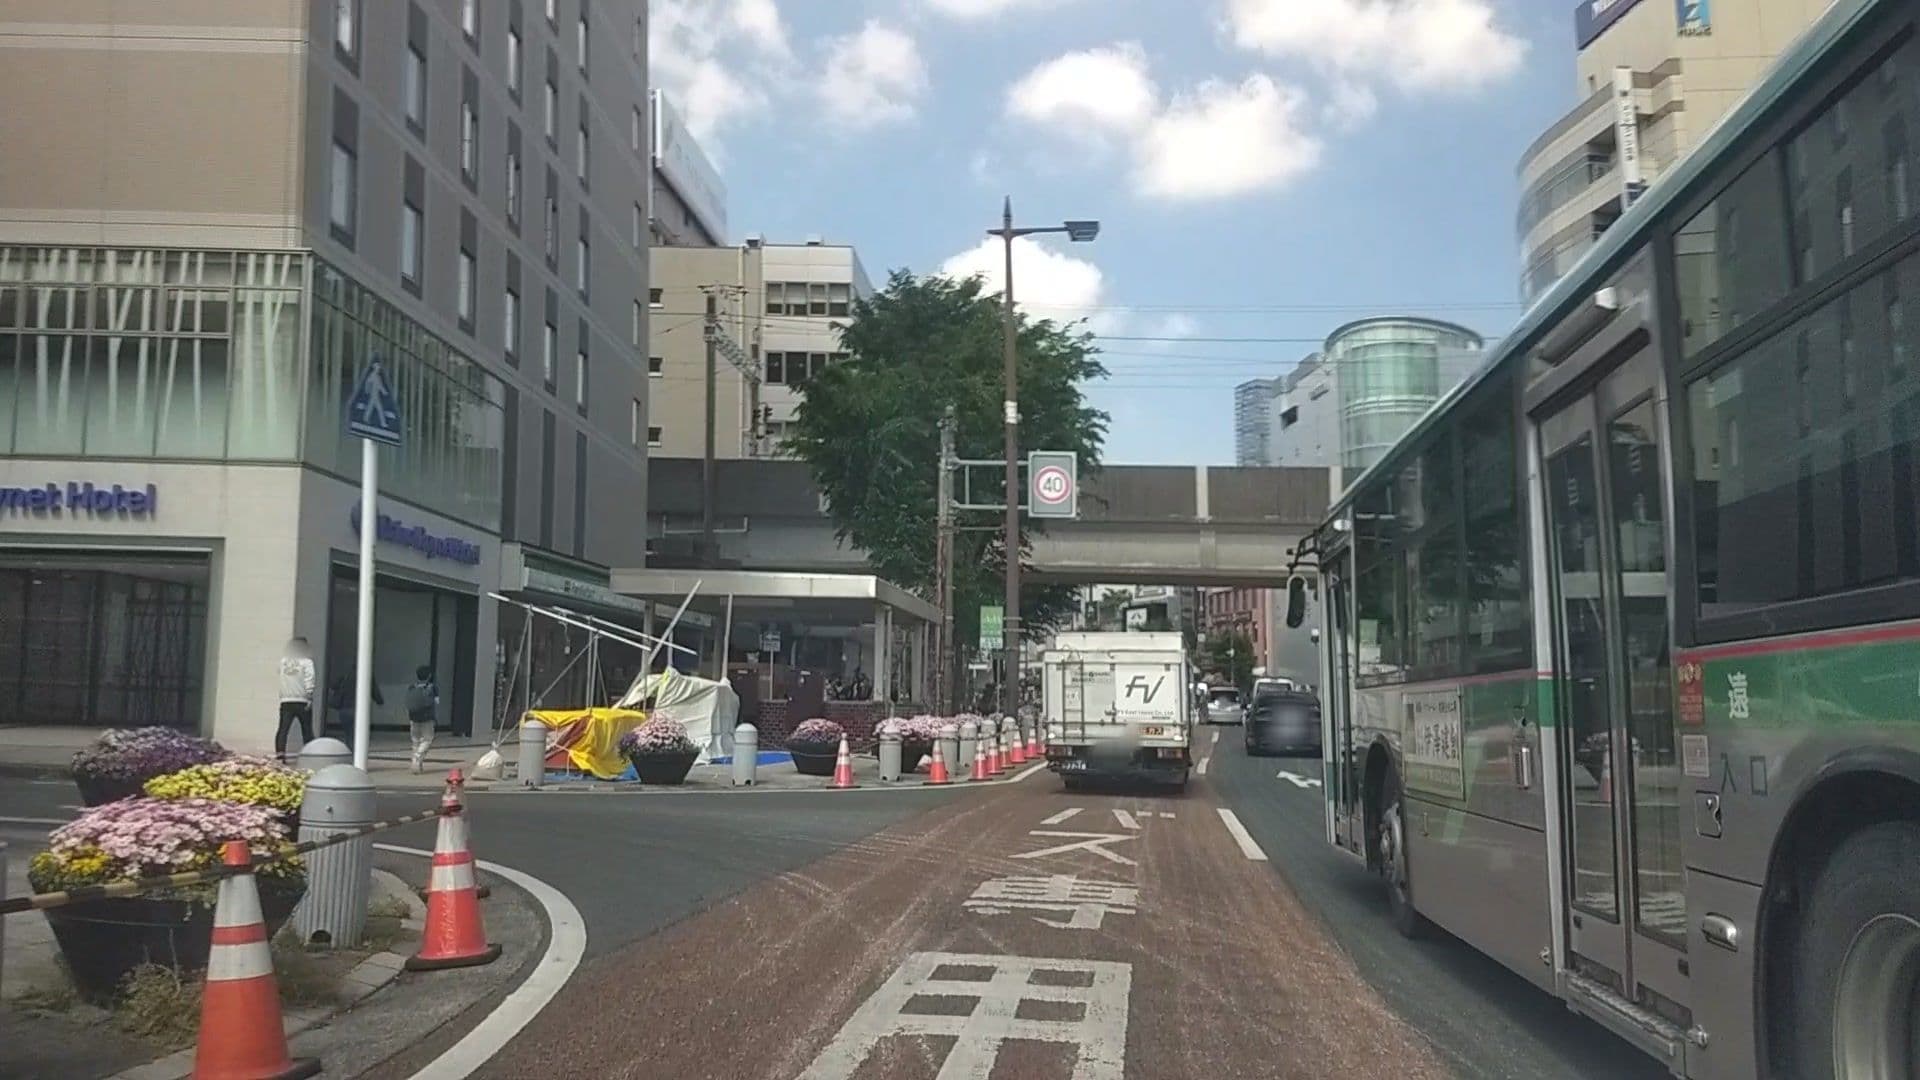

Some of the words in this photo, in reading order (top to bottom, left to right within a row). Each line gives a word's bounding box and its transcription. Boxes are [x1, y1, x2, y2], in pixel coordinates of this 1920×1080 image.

[67, 482, 157, 513] Hotel
[1042, 476, 1064, 493] 40
[1727, 671, 1750, 719] 遠
[1721, 752, 1768, 796] 入口
